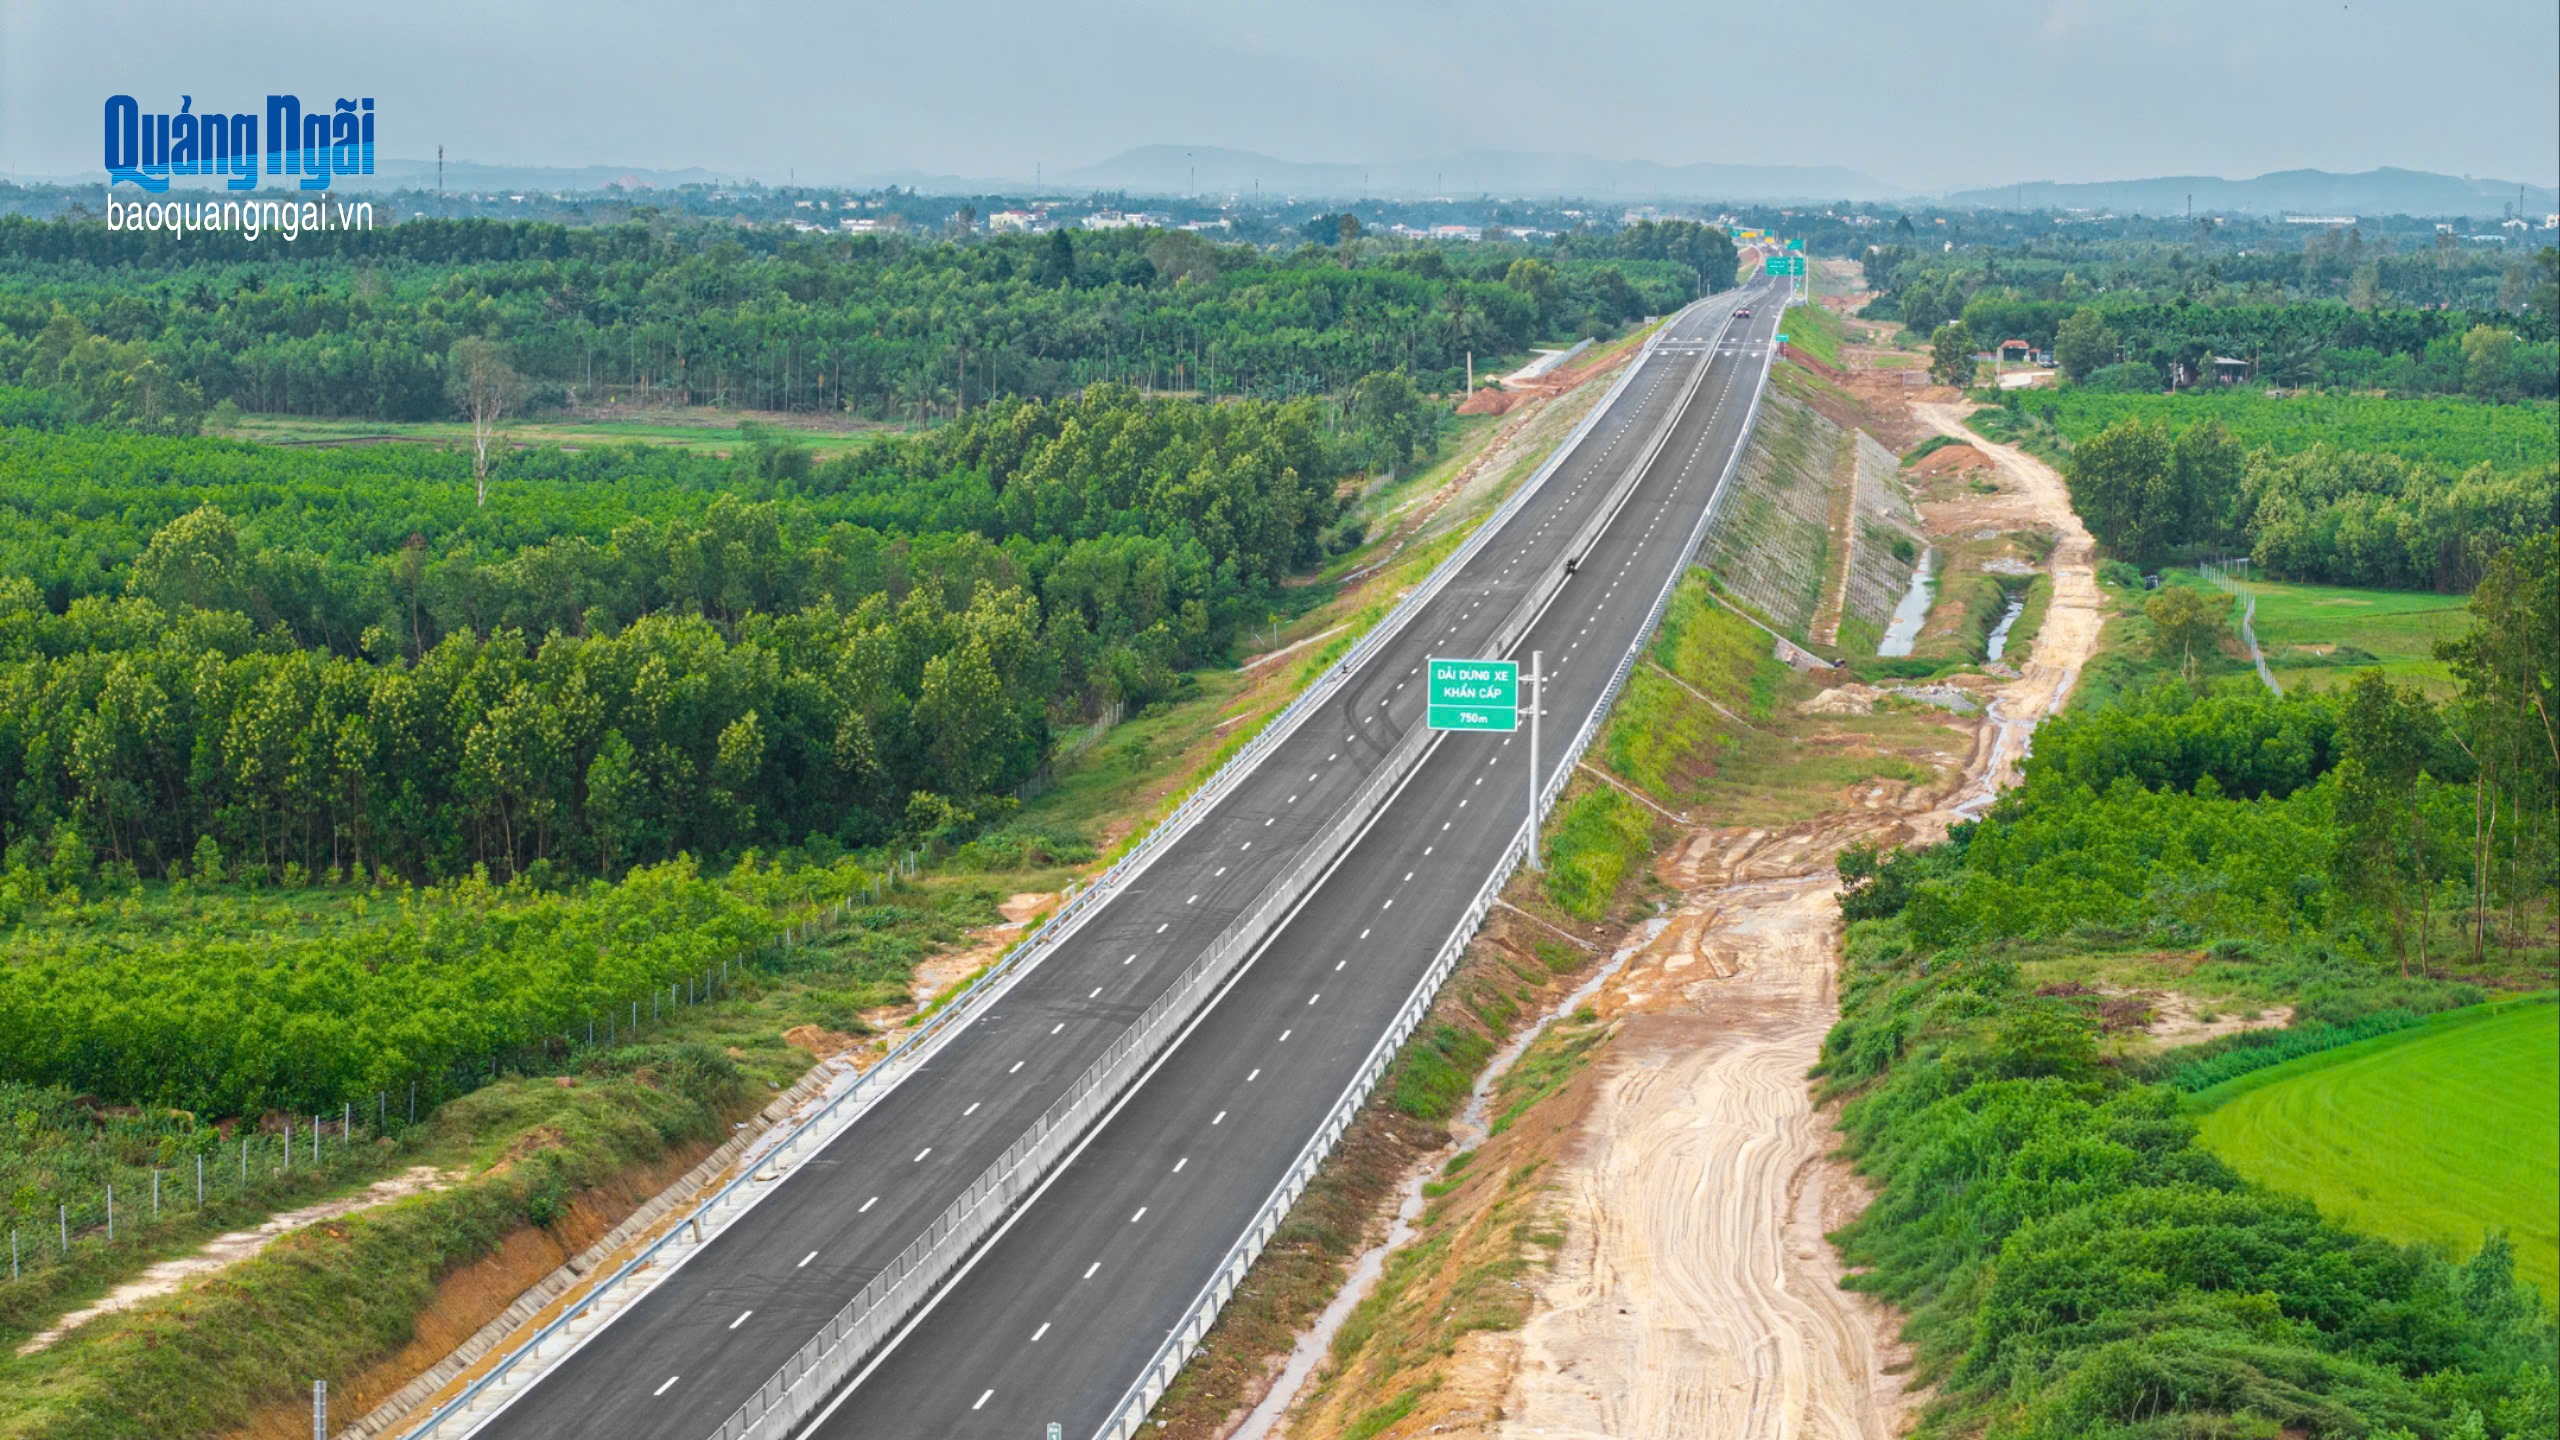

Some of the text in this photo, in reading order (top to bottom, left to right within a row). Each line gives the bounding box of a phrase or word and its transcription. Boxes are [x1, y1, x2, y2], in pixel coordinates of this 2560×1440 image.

[1494, 670, 1509, 681] XE
[1479, 685, 1501, 698] CẤP
[1459, 712, 1488, 723] 750m
